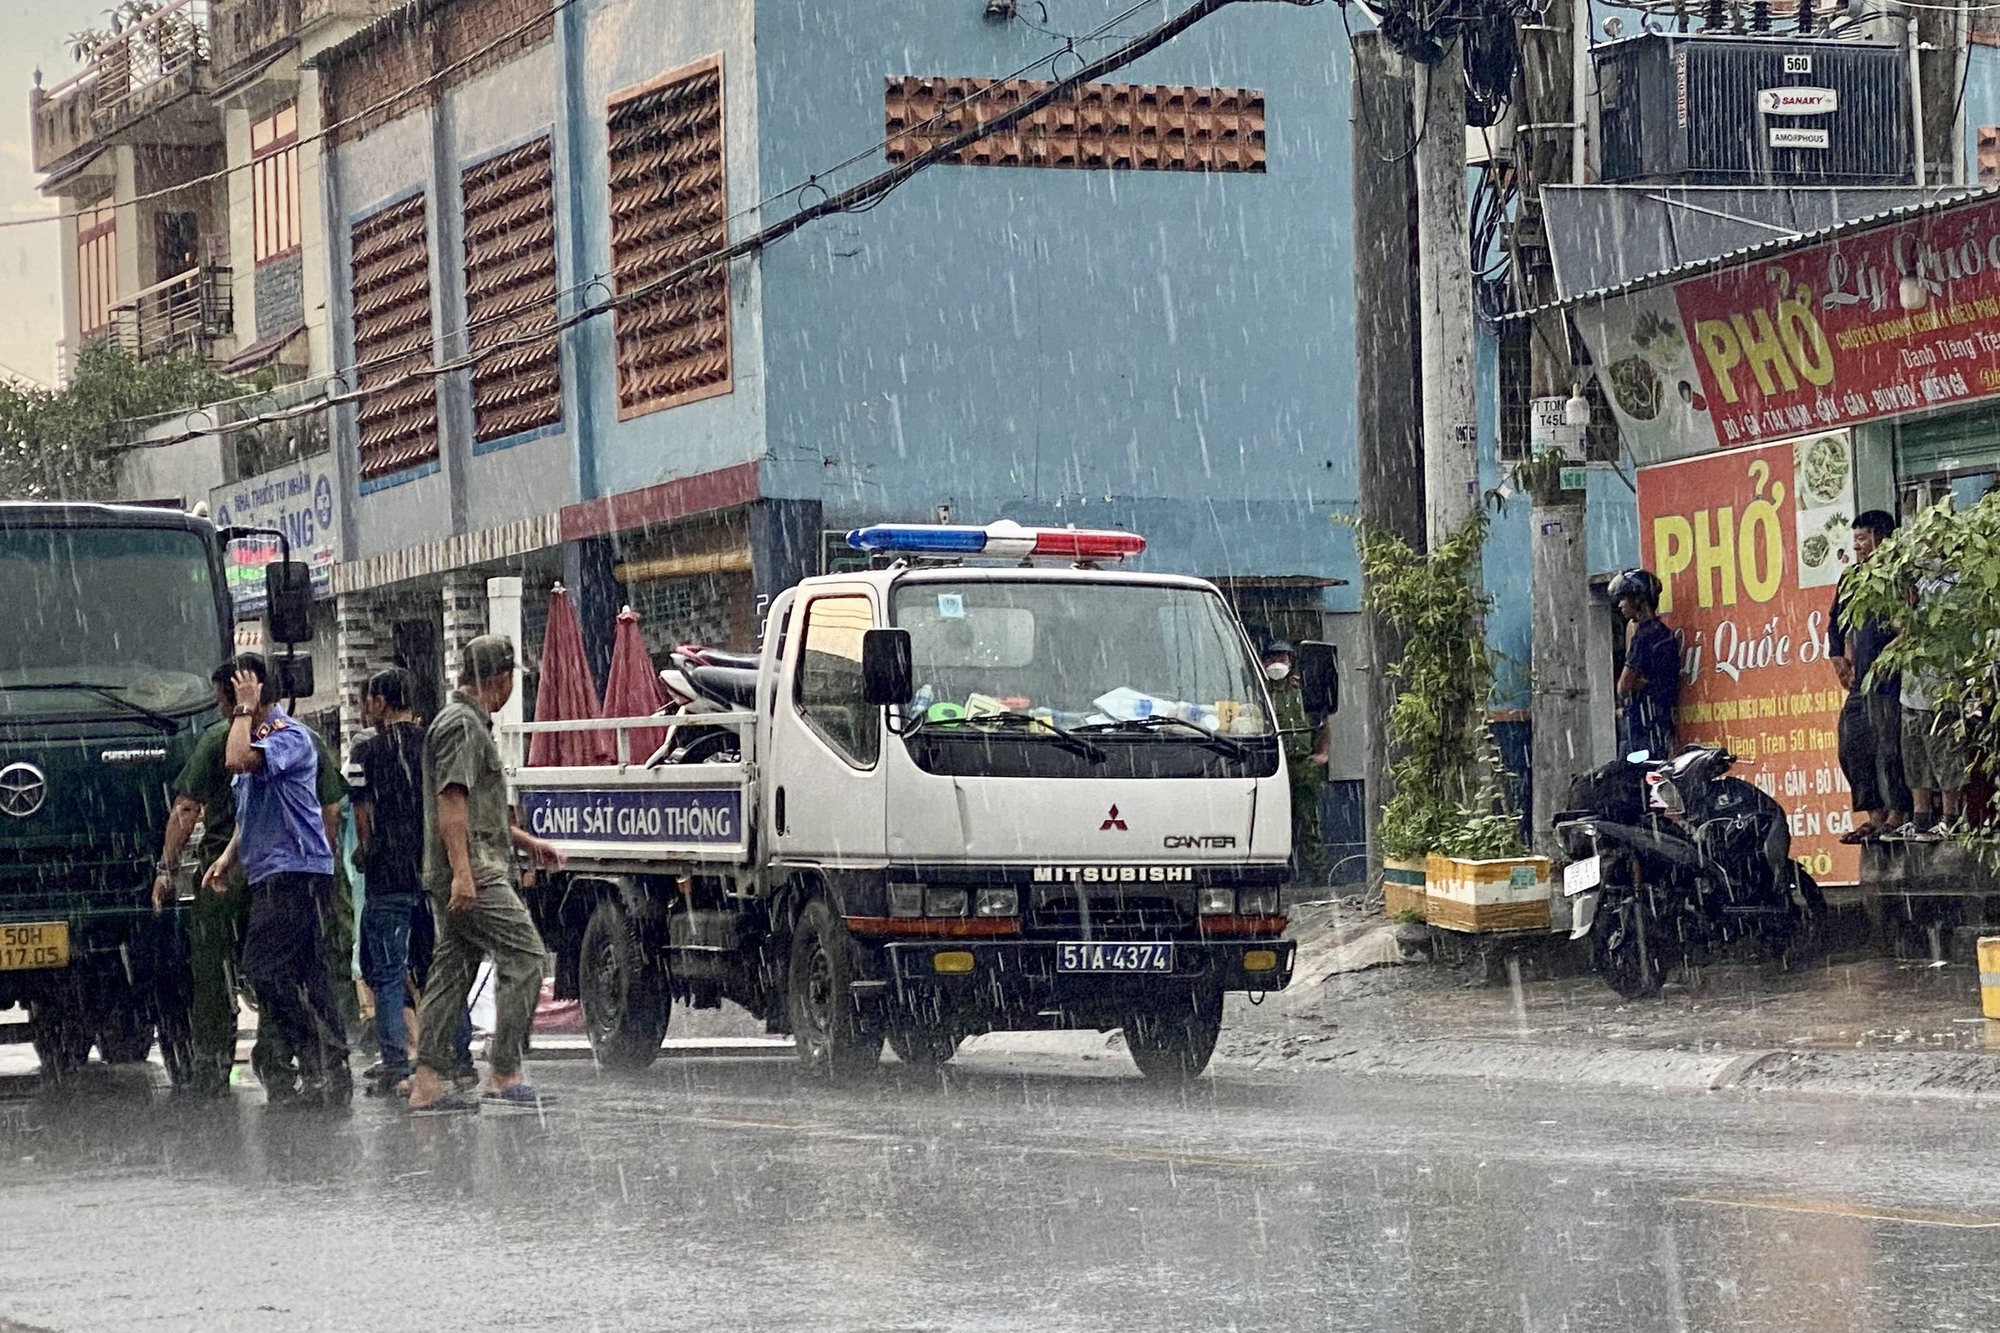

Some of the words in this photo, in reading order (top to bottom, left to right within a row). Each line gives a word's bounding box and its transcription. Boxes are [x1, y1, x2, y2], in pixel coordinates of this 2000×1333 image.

[1787, 57, 1808, 71] 560
[1782, 97, 1824, 105] SANAKY
[1775, 133, 1824, 143] AMORPHOUS
[1822, 251, 1887, 312] Lý
[1697, 266, 1834, 403] PHỞ
[1901, 343, 1937, 368] Danh
[1540, 415, 1566, 426] T45L
[1551, 430, 1556, 440] 1
[1654, 460, 1785, 613] PHỞ
[1713, 616, 1790, 683] Quốc
[1790, 729, 1805, 751] 50
[532, 799, 578, 834] CẢNH
[583, 798, 614, 834] SÁT
[617, 807, 660, 835] GIAO
[664, 799, 730, 836] THÔNG
[1786, 805, 1821, 836] IẾN
[1826, 805, 1854, 833] GÀ
[1163, 836, 1236, 849] CANTER
[1033, 867, 1193, 882] MITSUBISHI
[5, 928, 42, 946] 50H
[0, 946, 59, 966] 17.05
